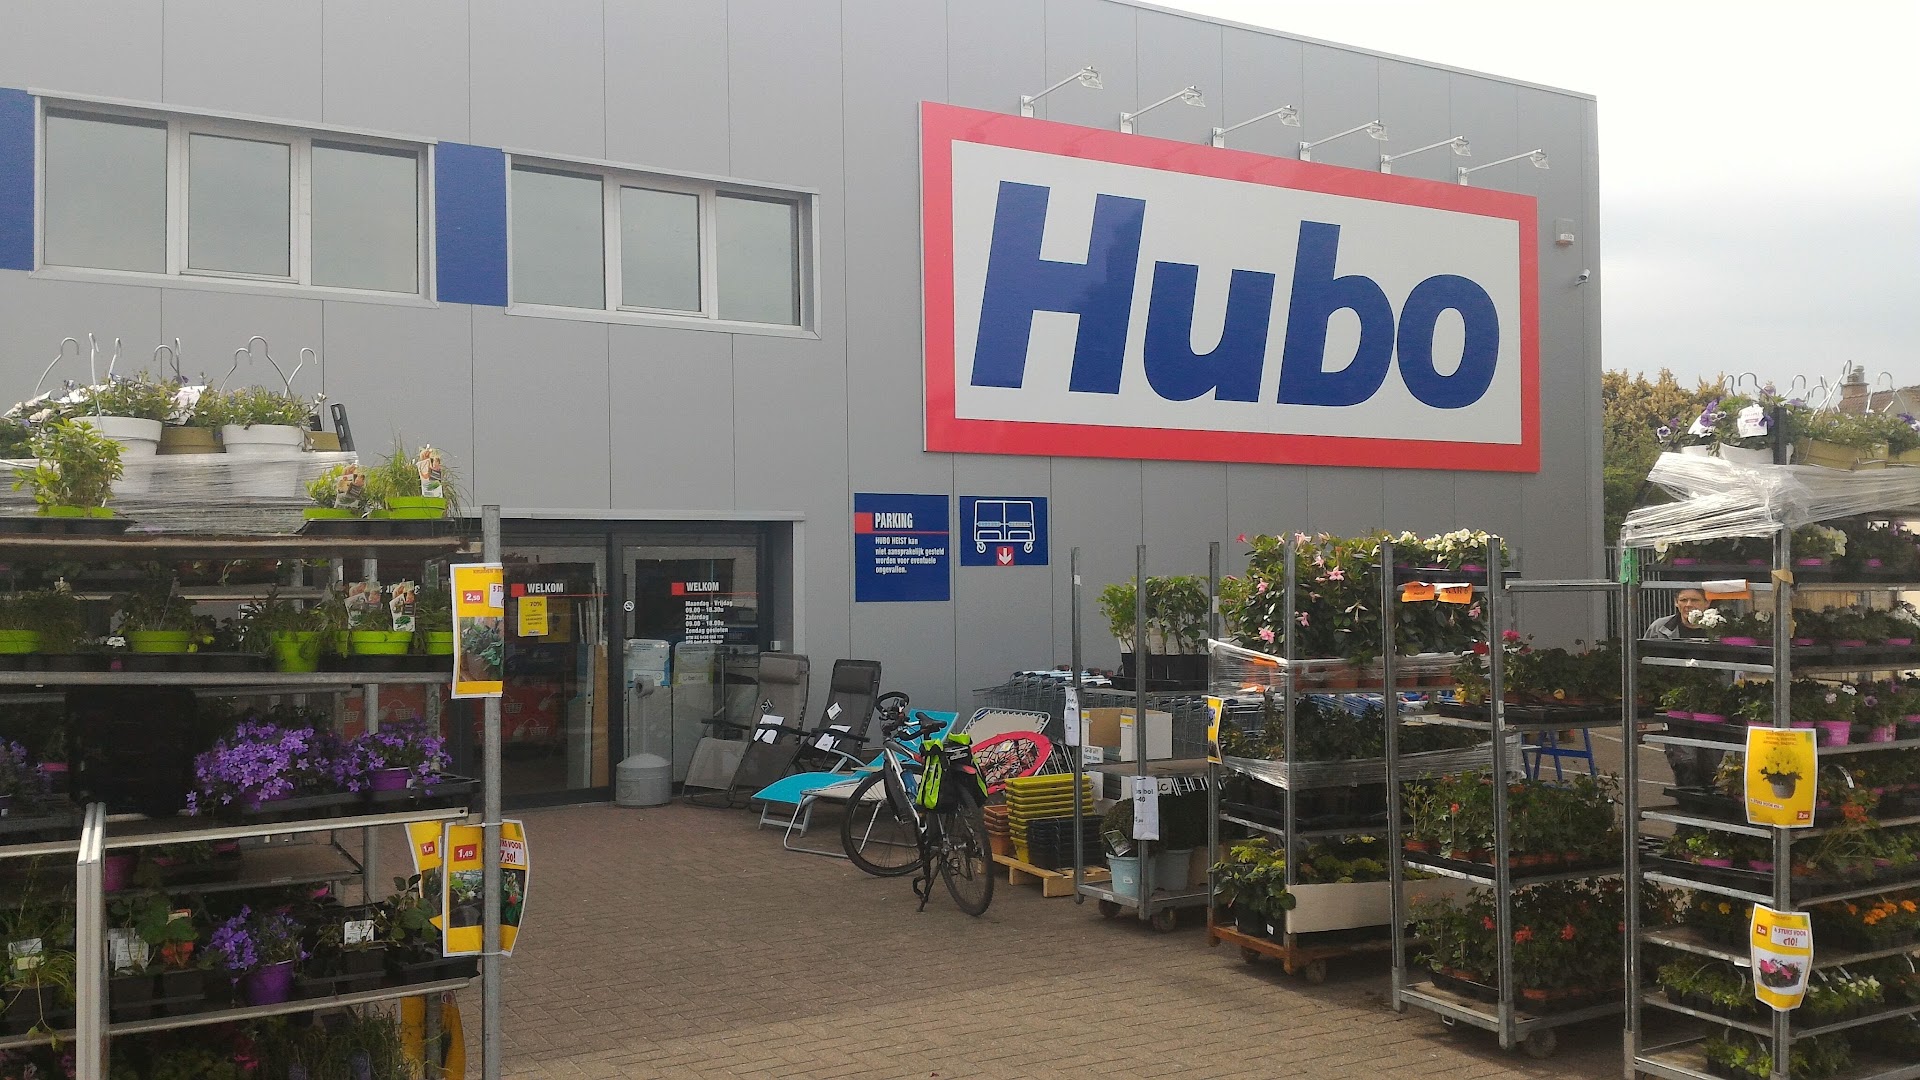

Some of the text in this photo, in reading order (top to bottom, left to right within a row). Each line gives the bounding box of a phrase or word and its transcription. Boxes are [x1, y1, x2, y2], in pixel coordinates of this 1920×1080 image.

[970, 180, 1500, 409] Hubo
[874, 512, 913, 529] PARKING
[875, 536, 919, 545] HUBO HEIST kan
[875, 547, 945, 556] niet aansprakelijk gesteld
[875, 556, 896, 564] worden
[910, 556, 937, 564] eventuele
[527, 583, 564, 593] WELKOM
[686, 582, 719, 591] WELKOM
[714, 599, 733, 607] Vrijdag
[508, 840, 522, 850] VOOR
[458, 848, 473, 858] 1,49
[1777, 928, 1792, 936] STUKS
